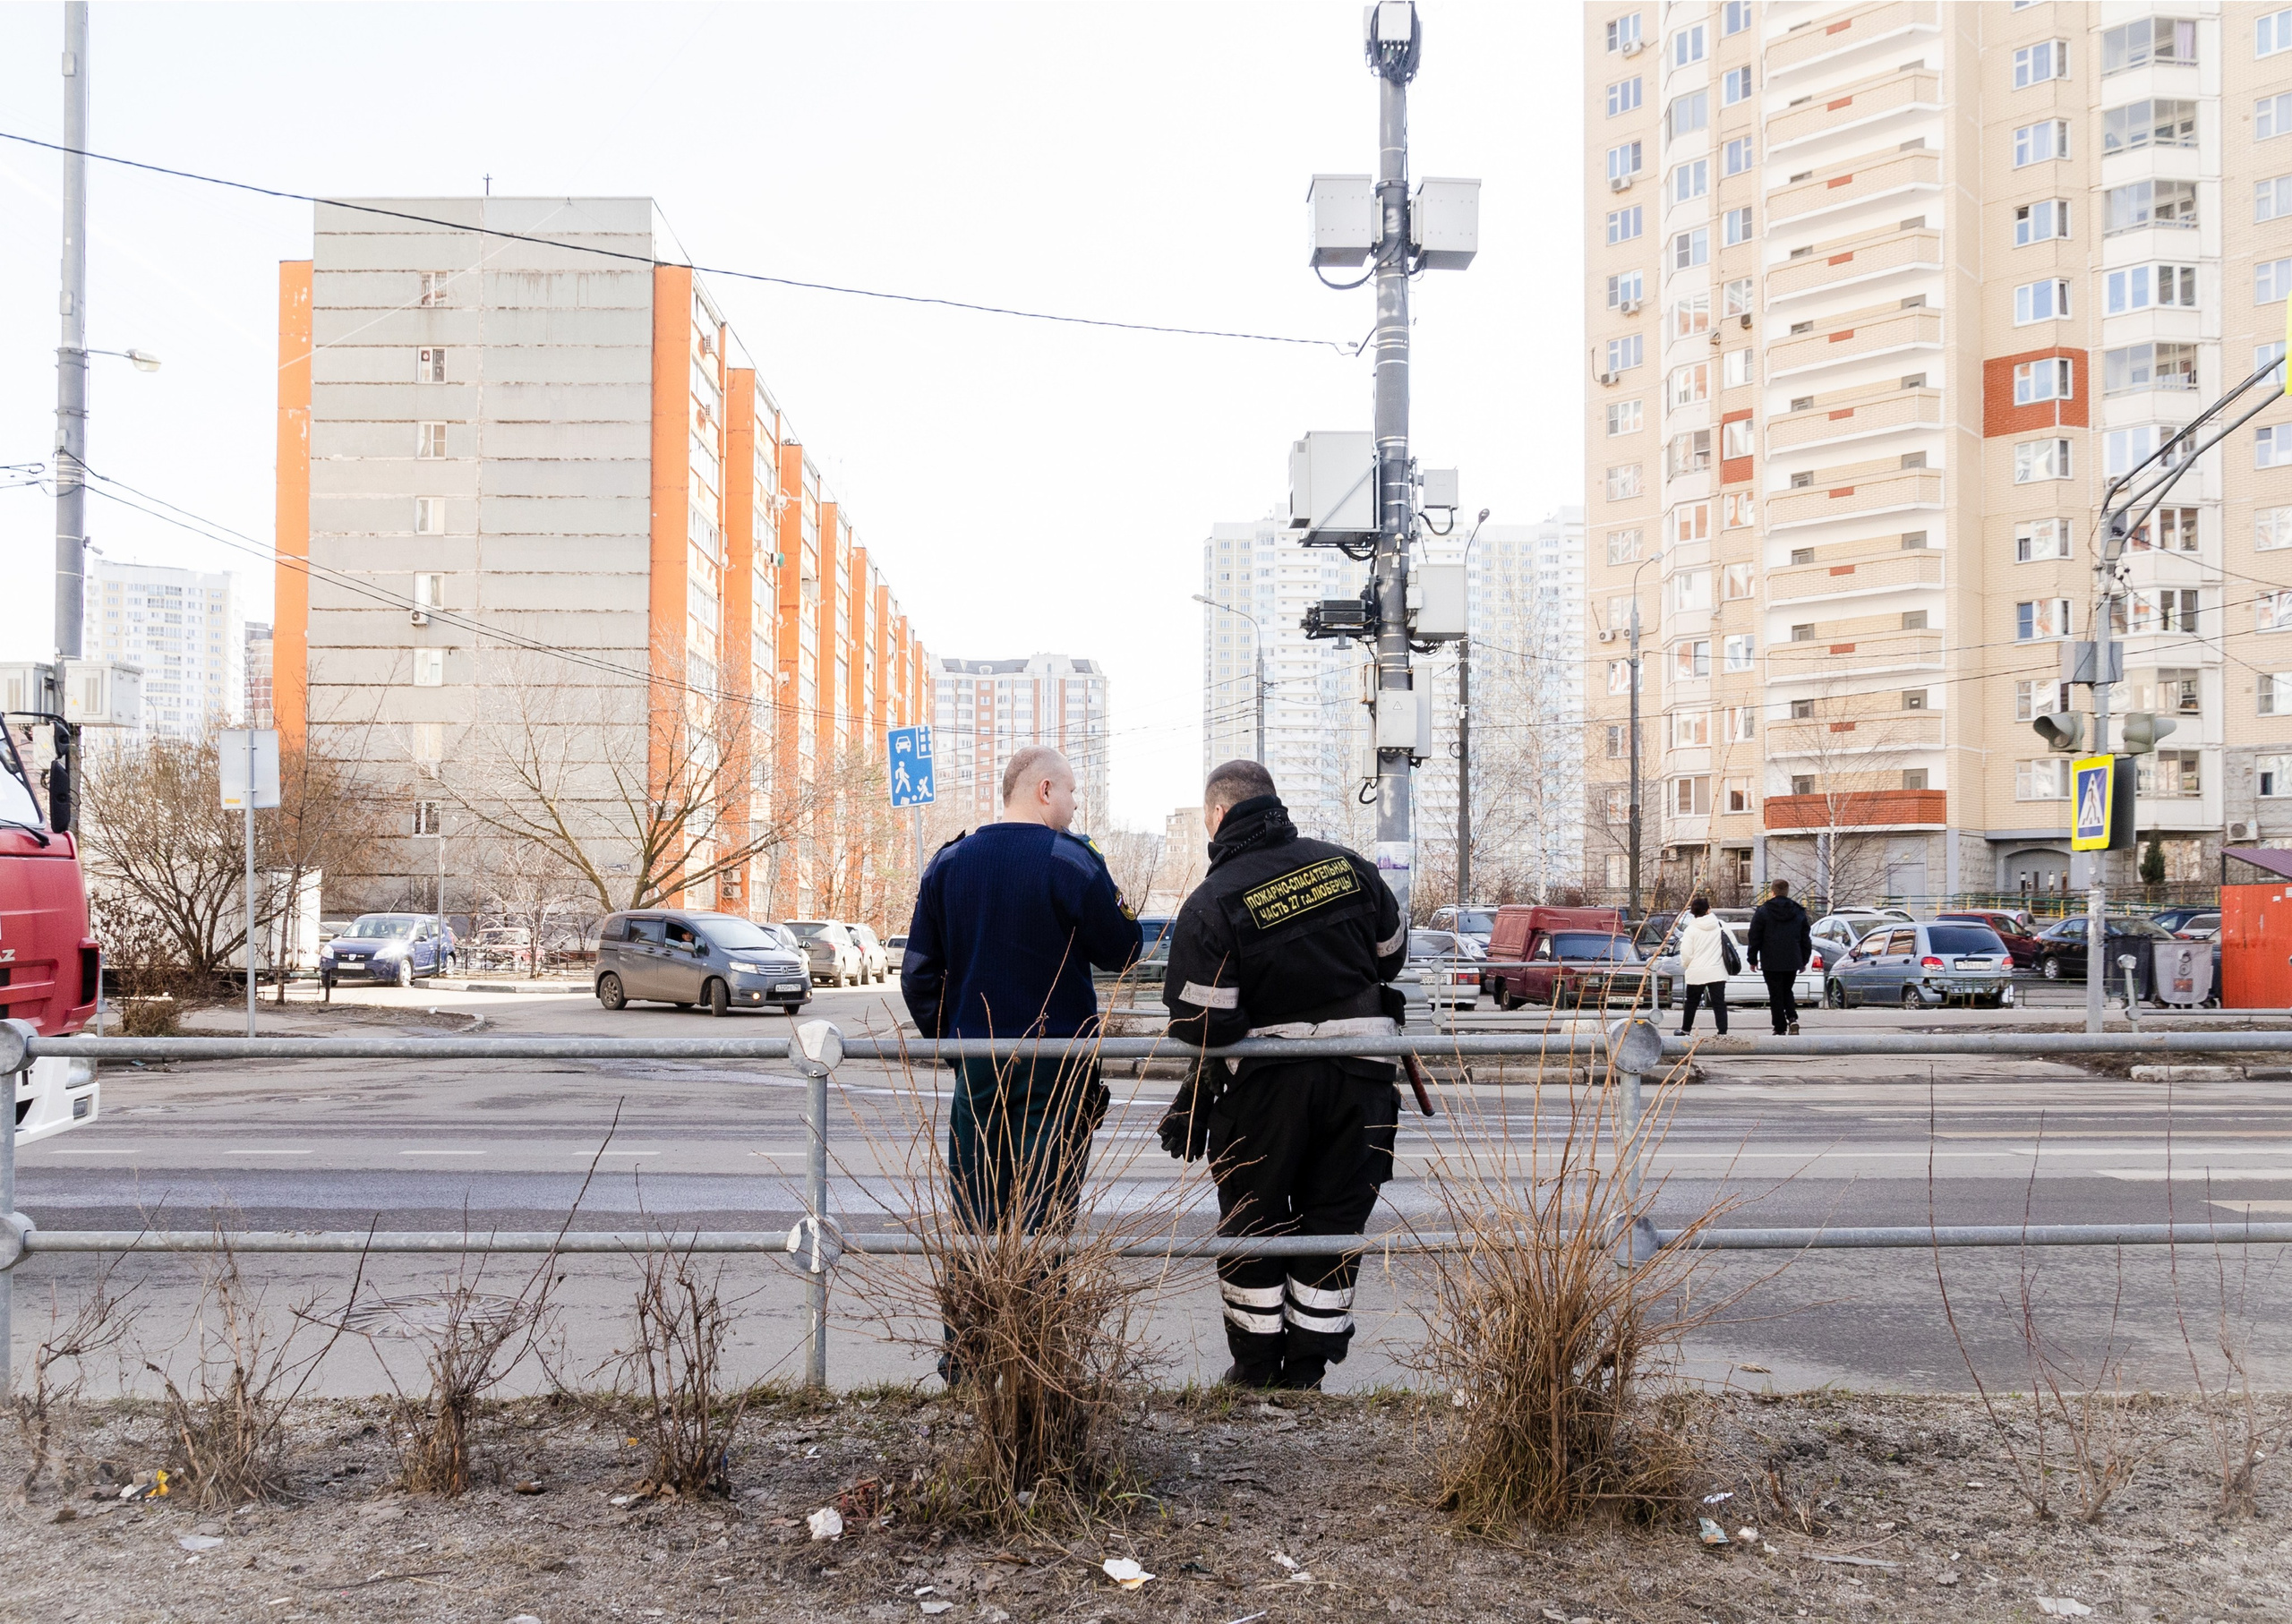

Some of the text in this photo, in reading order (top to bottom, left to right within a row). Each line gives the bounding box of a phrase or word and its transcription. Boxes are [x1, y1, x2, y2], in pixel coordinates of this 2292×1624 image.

[1246, 859, 1351, 909] ПОЖАРНО-СПАСАТЕЛЬНАЯ
[1259, 901, 1289, 922] ЧАСТЬ
[1288, 894, 1301, 910] 27
